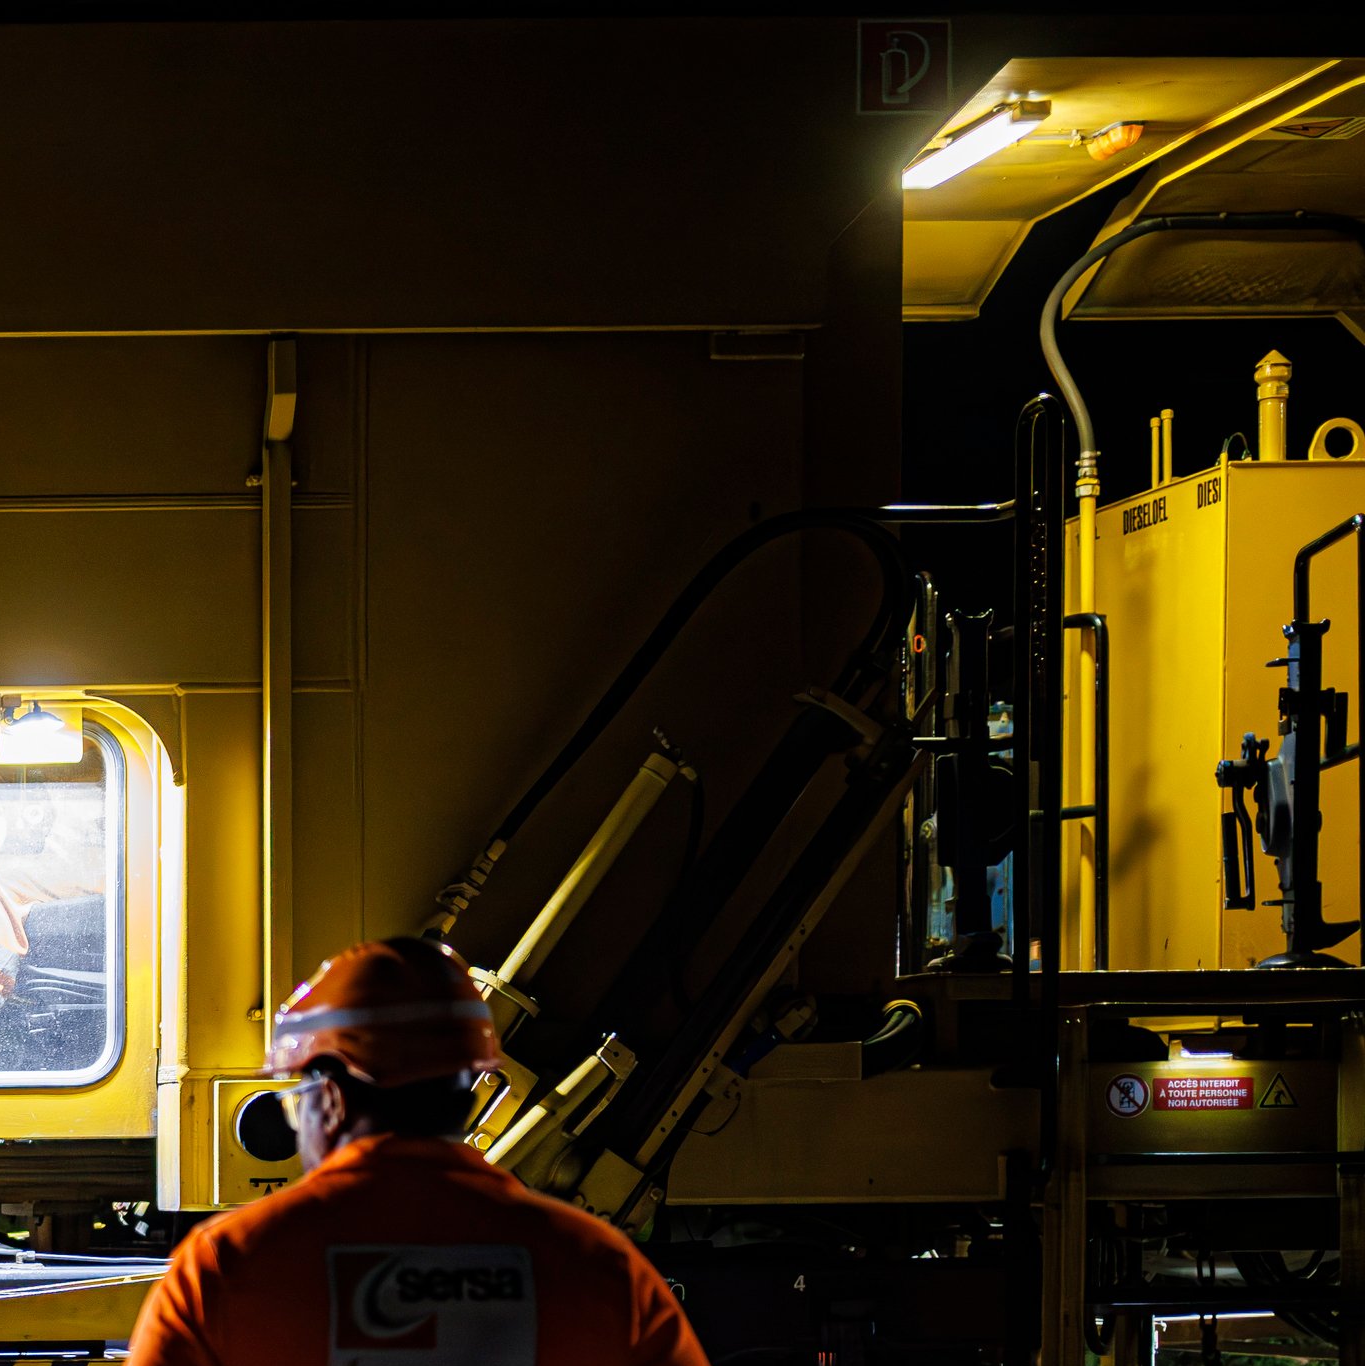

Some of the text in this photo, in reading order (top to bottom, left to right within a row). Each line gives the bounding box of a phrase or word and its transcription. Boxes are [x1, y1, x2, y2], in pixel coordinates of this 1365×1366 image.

[1123, 496, 1169, 536] DIESELOEL
[1168, 1079, 1239, 1088] ACCÈS INTERDIT
[1168, 1089, 1197, 1097] TOUTE
[1199, 1089, 1247, 1097] PERSONNE
[1168, 1099, 1187, 1107] NON
[397, 1267, 523, 1303] sersa
